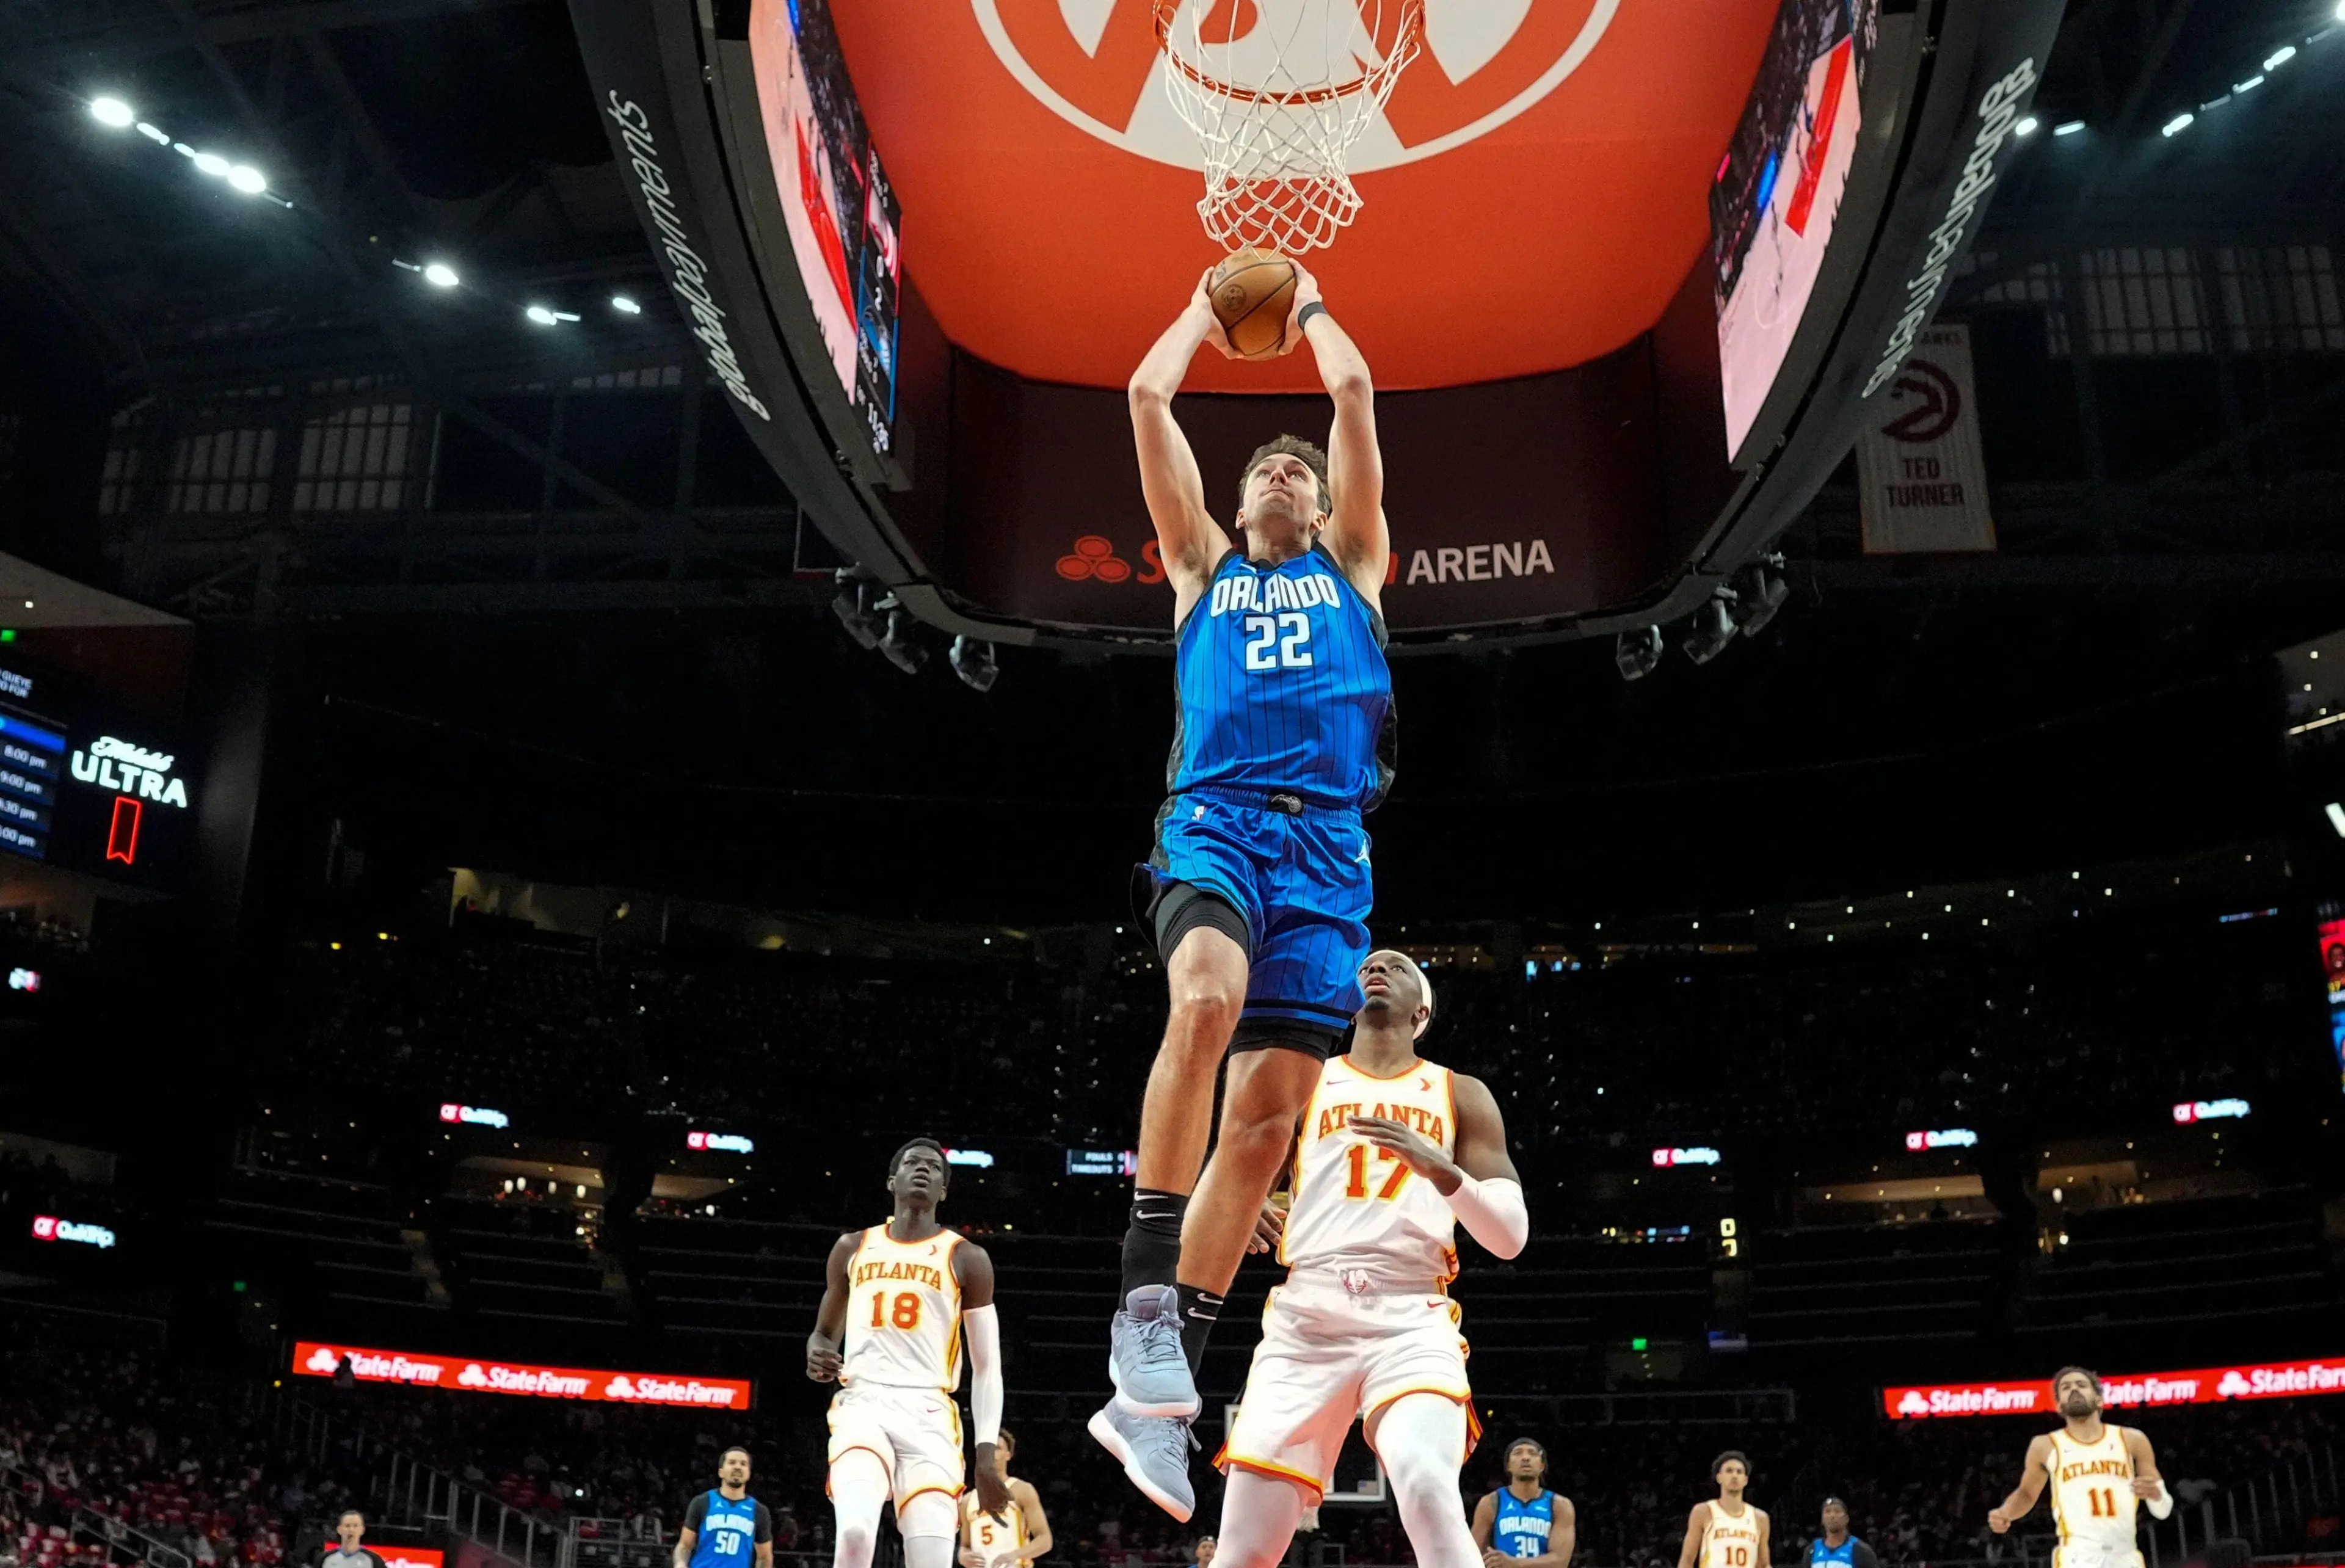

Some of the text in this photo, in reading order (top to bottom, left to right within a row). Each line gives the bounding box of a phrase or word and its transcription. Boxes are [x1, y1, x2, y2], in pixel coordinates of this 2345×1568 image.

[1902, 457, 1941, 481] TED
[1886, 482, 1965, 508] TURNER
[1406, 539, 1555, 586] ARENA
[1210, 572, 1341, 618] ORLANDO
[1245, 612, 1312, 670] 22
[71, 750, 187, 808] ULTRA
[1346, 1144, 1412, 1200] 17
[855, 1261, 942, 1291] ATLANTA
[871, 1290, 920, 1329] 18
[2103, 1378, 2197, 1404] tateFarm
[2062, 1460, 2129, 1483] ATLANTA
[2088, 1487, 2115, 1517] 11
[714, 1530, 741, 1555] 50
[980, 1524, 994, 1545] 5
[1514, 1534, 1540, 1559] 34
[1726, 1545, 1747, 1567] 10
